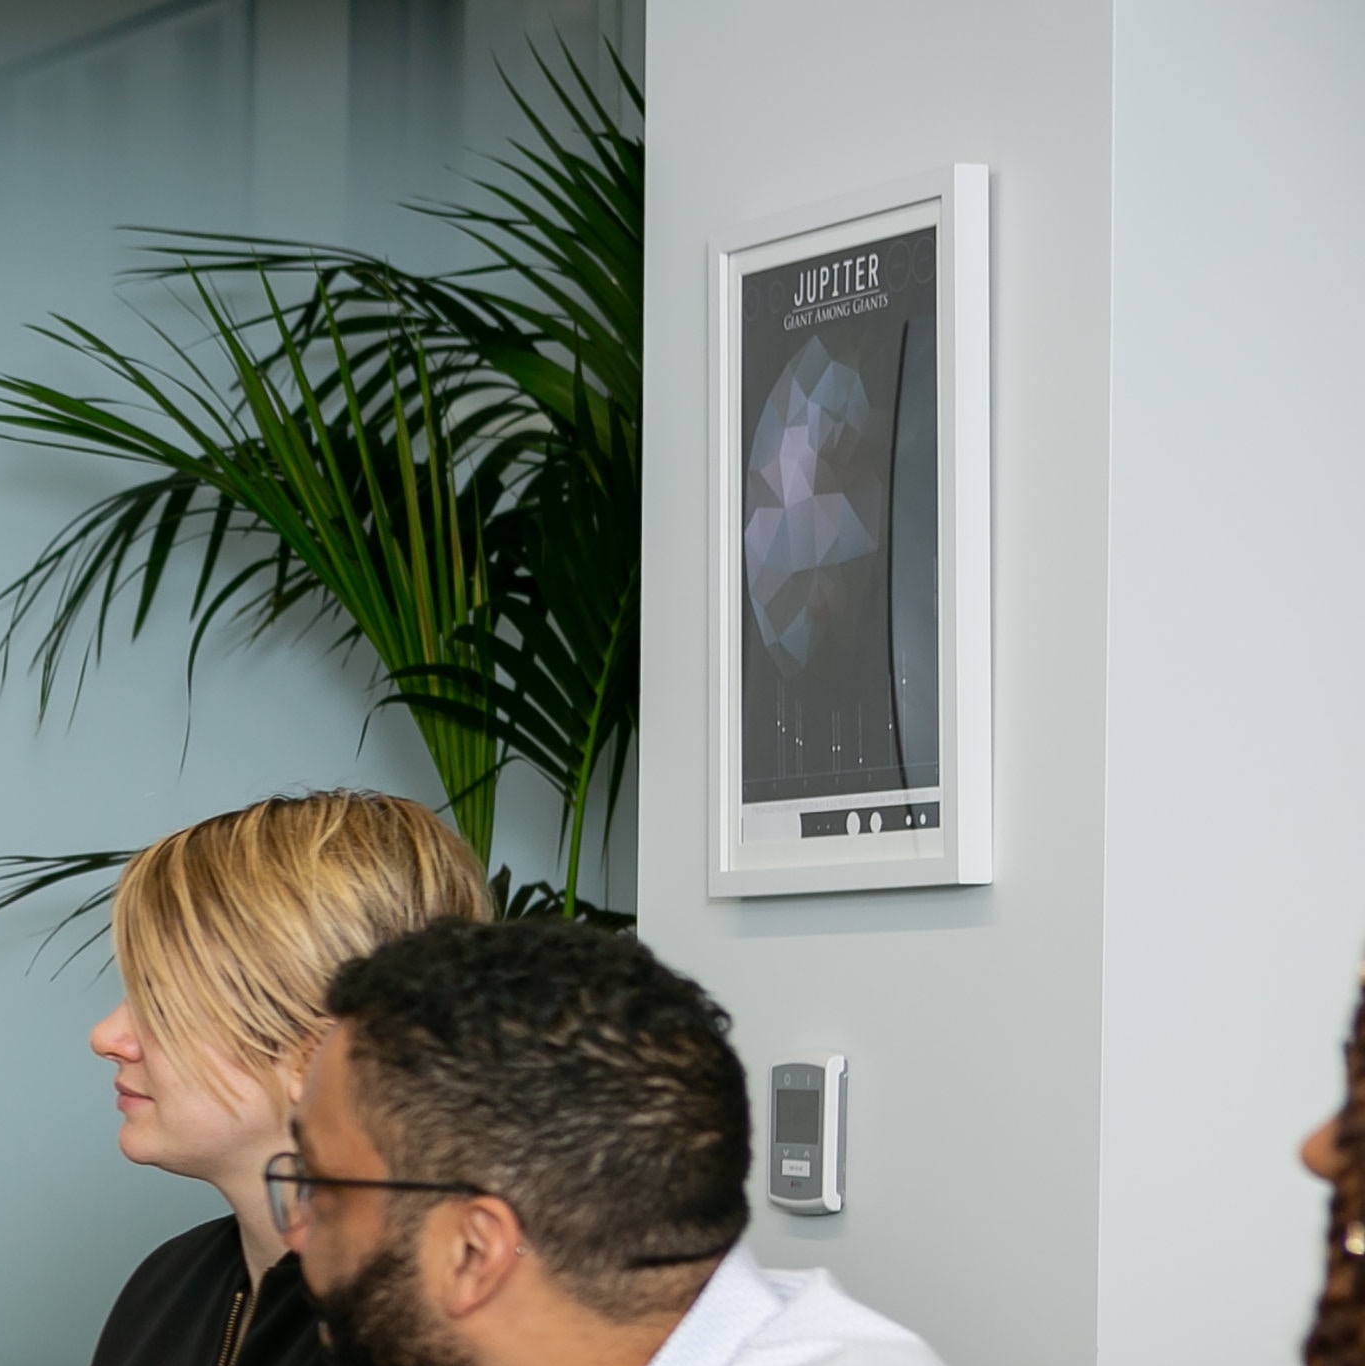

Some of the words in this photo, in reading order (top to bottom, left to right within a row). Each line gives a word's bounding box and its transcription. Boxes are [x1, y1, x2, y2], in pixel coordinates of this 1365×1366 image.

[794, 253, 879, 307] JUPITER
[783, 310, 813, 331] GIANT
[815, 302, 850, 323] AMONG
[852, 293, 889, 314] GIANTS
